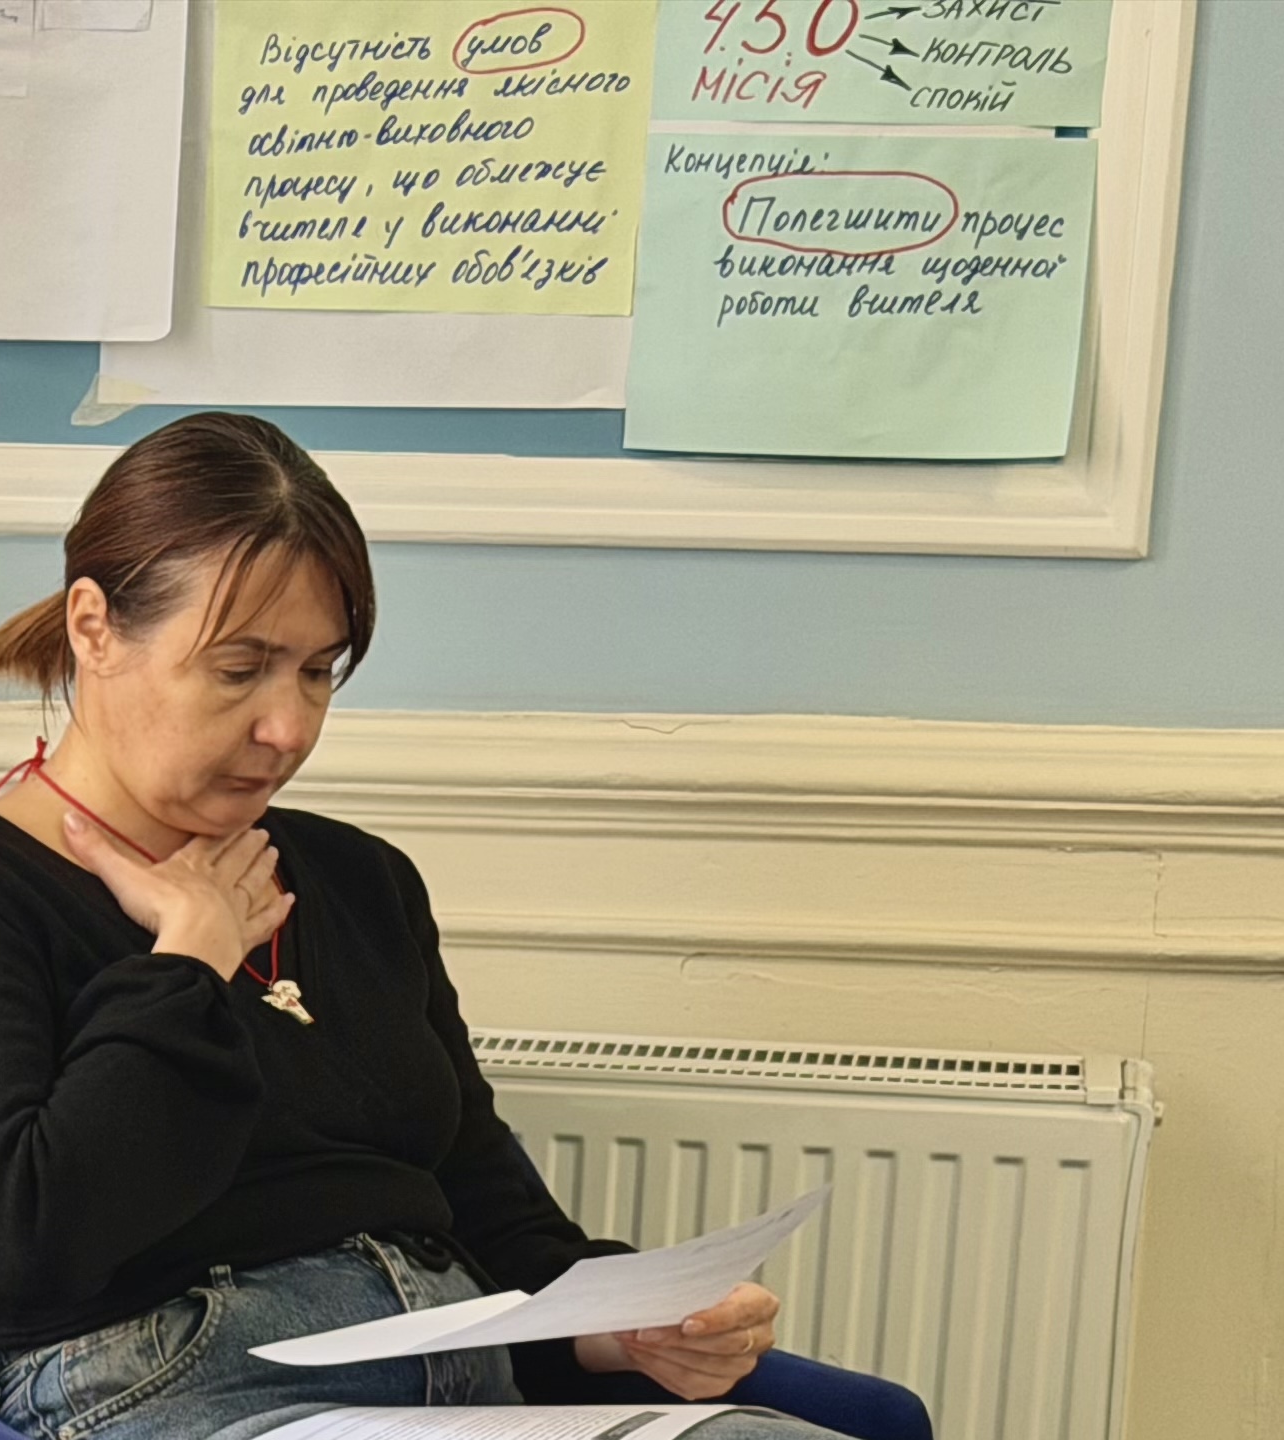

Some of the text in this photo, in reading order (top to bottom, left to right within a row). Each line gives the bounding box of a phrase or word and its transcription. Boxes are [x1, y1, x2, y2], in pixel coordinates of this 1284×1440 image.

[259, 22, 553, 74] Відсутність умов
[921, 37, 1073, 74] КОНТРОЛЬ
[238, 69, 631, 116] для проведення якісного
[691, 56, 828, 110] МІСІЯ
[910, 80, 1018, 112] СПОКІЙ
[392, 168, 441, 197] що
[455, 157, 608, 188] обмежує
[384, 216, 405, 249] у
[421, 201, 619, 239] виконанні
[737, 195, 1065, 250] Полегшити процес
[240, 252, 437, 298] професійних
[713, 244, 1068, 286] виконання щоденної
[716, 284, 984, 328] роботи вчителя
